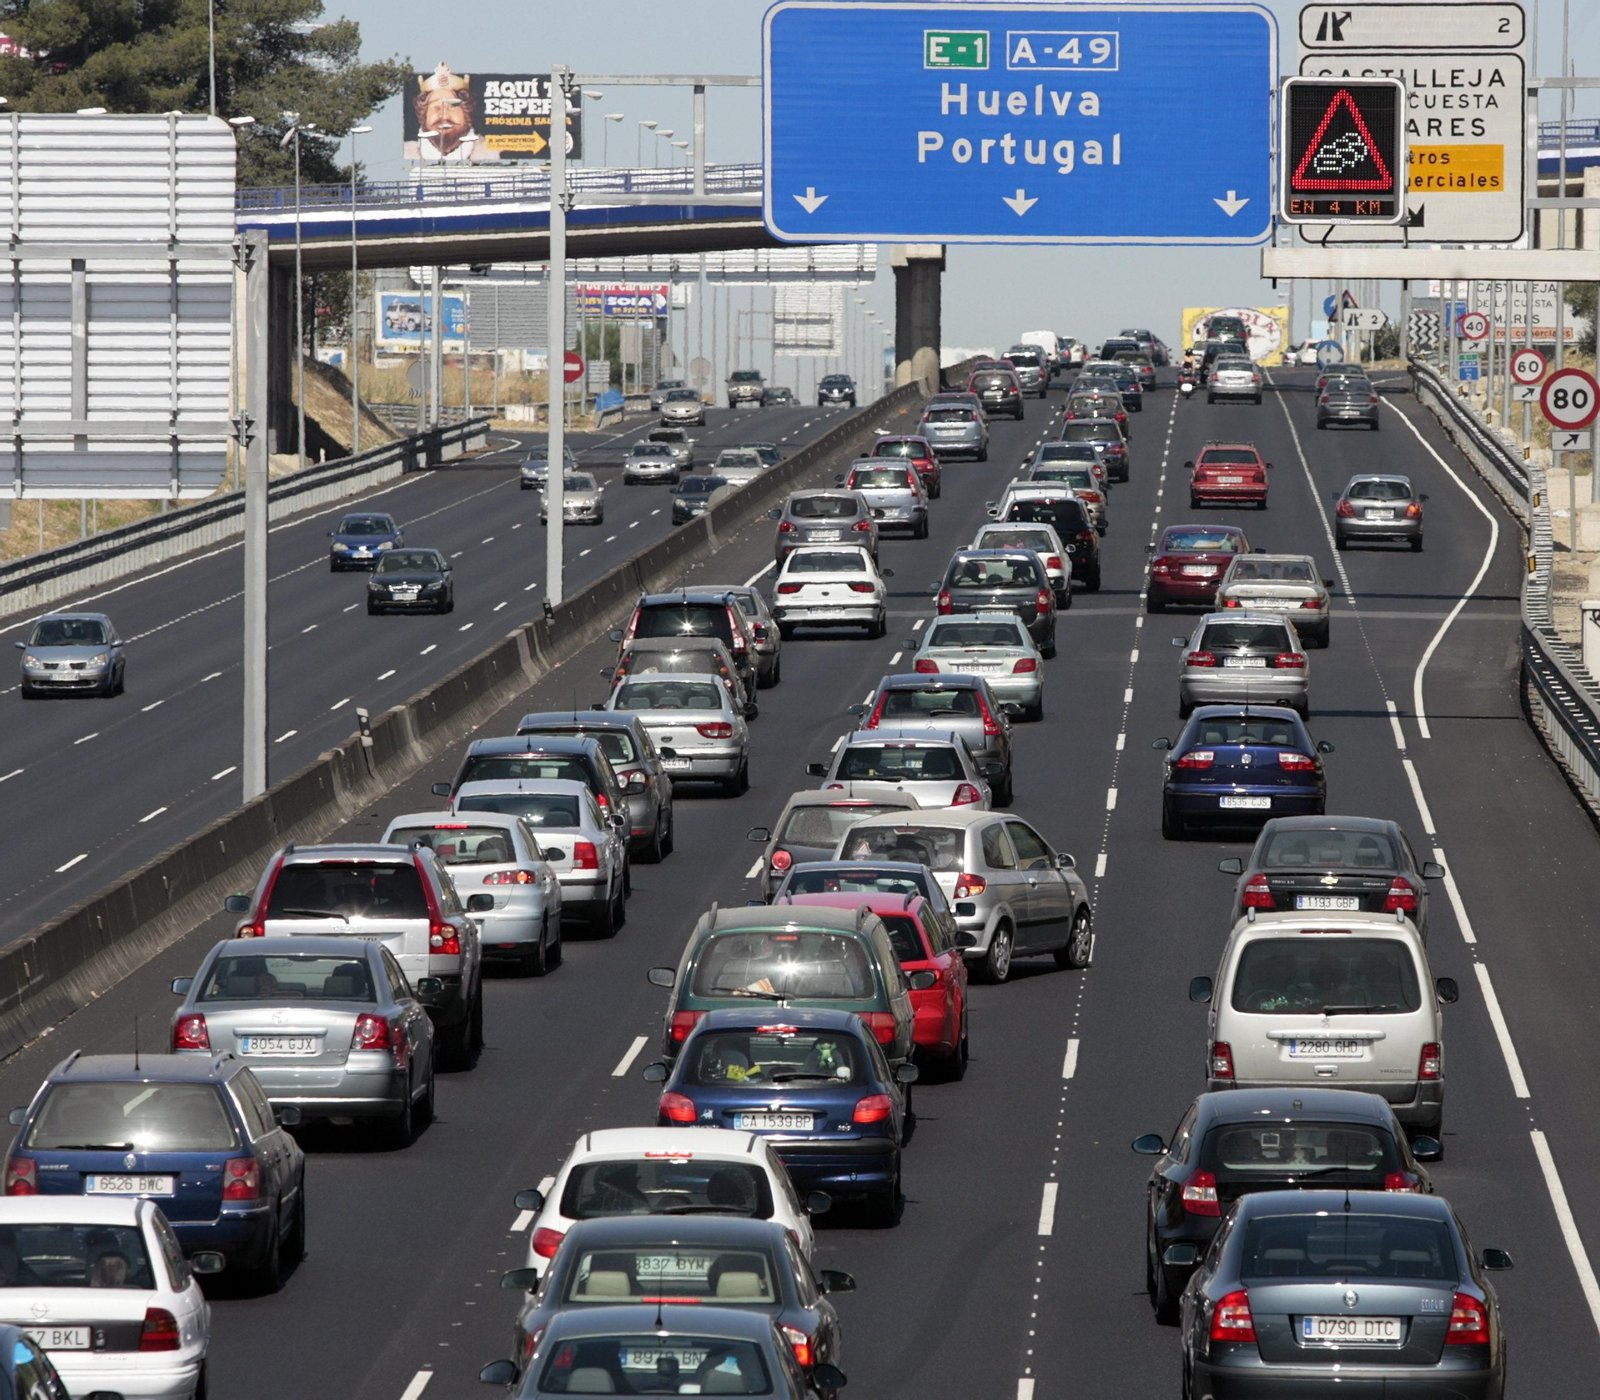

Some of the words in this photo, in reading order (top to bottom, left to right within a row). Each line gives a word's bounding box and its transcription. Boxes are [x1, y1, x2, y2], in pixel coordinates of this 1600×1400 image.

[1498, 17, 1510, 33] 2
[930, 36, 983, 63] E-1
[1011, 37, 1111, 64] A-49
[484, 78, 539, 98] AQUÍ
[941, 82, 1100, 116] Huelva
[918, 131, 1120, 174] Portugal
[1291, 200, 1315, 213] EN
[1330, 201, 1340, 213] 4
[1356, 200, 1381, 214] KM
[1371, 315, 1378, 324] 2
[1466, 321, 1484, 332] 40
[1517, 361, 1539, 373] 60
[1553, 388, 1588, 409] 80
[1308, 897, 1331, 907] 1193
[1336, 898, 1355, 908] GBP
[251, 1038, 283, 1049] 8054
[288, 1038, 313, 1050] GJX
[1300, 1041, 1330, 1053] 2280
[1335, 1041, 1358, 1053] GHD
[741, 1115, 757, 1127] CA
[763, 1115, 792, 1127] 1539
[795, 1116, 811, 1128] BP
[100, 1178, 132, 1191] 6526
[139, 1178, 164, 1191] BWC
[678, 1258, 705, 1270] BYM
[1318, 1319, 1357, 1335] 0790
[1364, 1320, 1394, 1336] DTC
[52, 1331, 84, 1345] BKL
